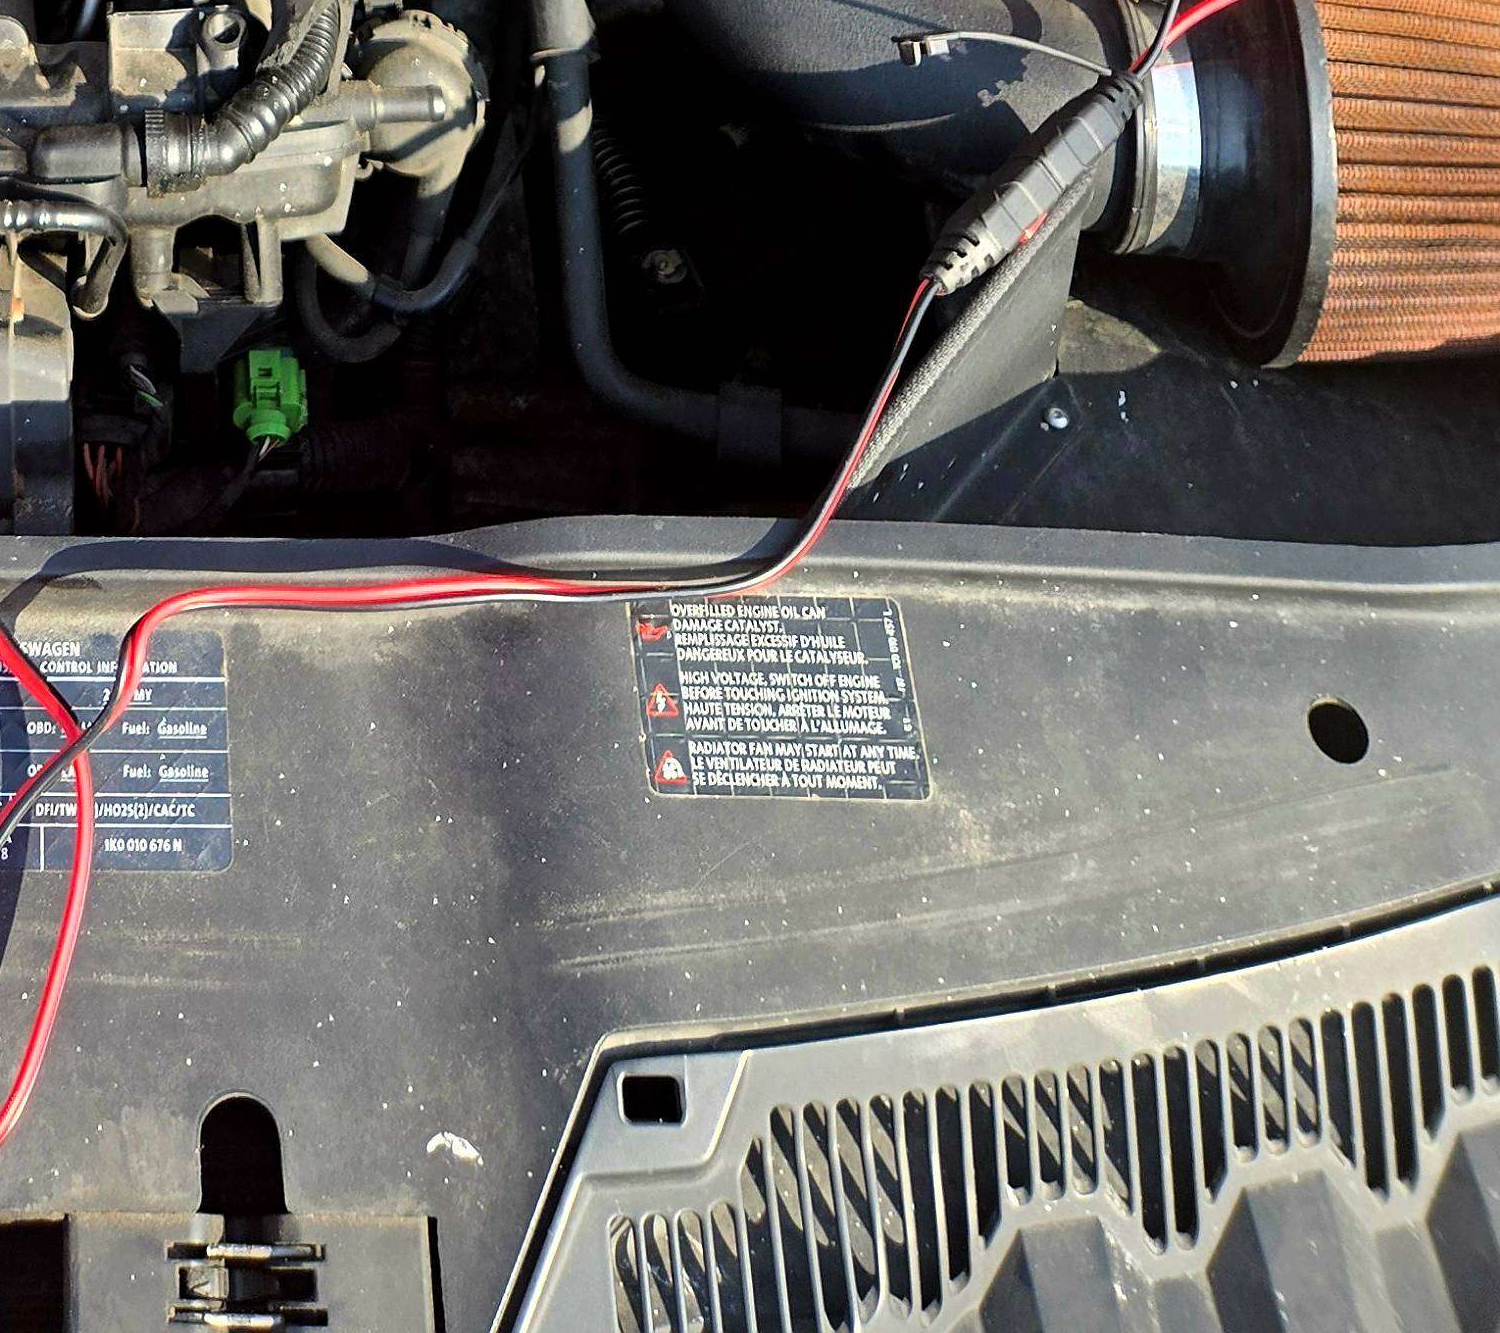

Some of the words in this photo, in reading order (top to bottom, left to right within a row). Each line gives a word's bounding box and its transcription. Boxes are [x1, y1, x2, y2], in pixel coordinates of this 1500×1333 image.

[671, 604, 736, 618] OVERFILLED
[737, 604, 780, 619] ENGINE
[781, 605, 800, 620] OIL
[801, 606, 826, 621] CAN
[673, 618, 724, 632] DAMAGE
[724, 620, 783, 633] CATALYST.
[674, 632, 750, 648] REMPLISSAGE
[751, 634, 799, 649] EXCESSIF
[800, 635, 846, 649] D'HUILE
[676, 647, 746, 662] DANGEREUX
[747, 648, 779, 663] POUR
[780, 649, 794, 663] LE
[794, 649, 869, 665] CATALYSEUR.
[40, 661, 93, 674] CONTROL
[97, 661, 177, 674] INFATION
[679, 671, 710, 685] HIGH
[768, 673, 813, 687] SWITCH
[814, 674, 837, 688] OFF
[838, 674, 881, 689] ENGINE
[681, 686, 723, 700] BEFORE
[724, 686, 786, 702] TOUCHING
[786, 688, 840, 703] IGNITION
[841, 689, 889, 705] SYSTEM.
[684, 701, 722, 716] HAUTE
[827, 704, 841, 719] LE
[842, 704, 891, 720] MOTEUR
[26, 721, 56, 735] OBD:
[122, 722, 150, 735] Fuel:
[157, 720, 207, 735] Gasoline
[686, 716, 726, 731] AVANT
[728, 717, 744, 731] DE
[744, 717, 798, 732] TOUCHER
[688, 740, 747, 756] RADIATOR
[748, 742, 774, 757] FAN
[775, 742, 803, 757] MAY
[805, 743, 840, 758] START
[842, 744, 858, 759] AT
[860, 745, 886, 759] ANY
[886, 745, 920, 760] TIME.
[123, 764, 151, 778] Fuel:
[159, 764, 209, 779] Gasoline
[691, 756, 705, 771] LE
[706, 756, 783, 772] VENTILATEUR
[784, 758, 801, 772] DE
[801, 759, 867, 774] RADIATEUR
[867, 760, 897, 775] PEUT
[692, 771, 707, 786] SE
[791, 773, 823, 788] TOUT
[825, 775, 883, 790] MOMENT.
[104, 838, 124, 852] 1K0
[127, 838, 147, 852] 010
[150, 838, 170, 852] 676
